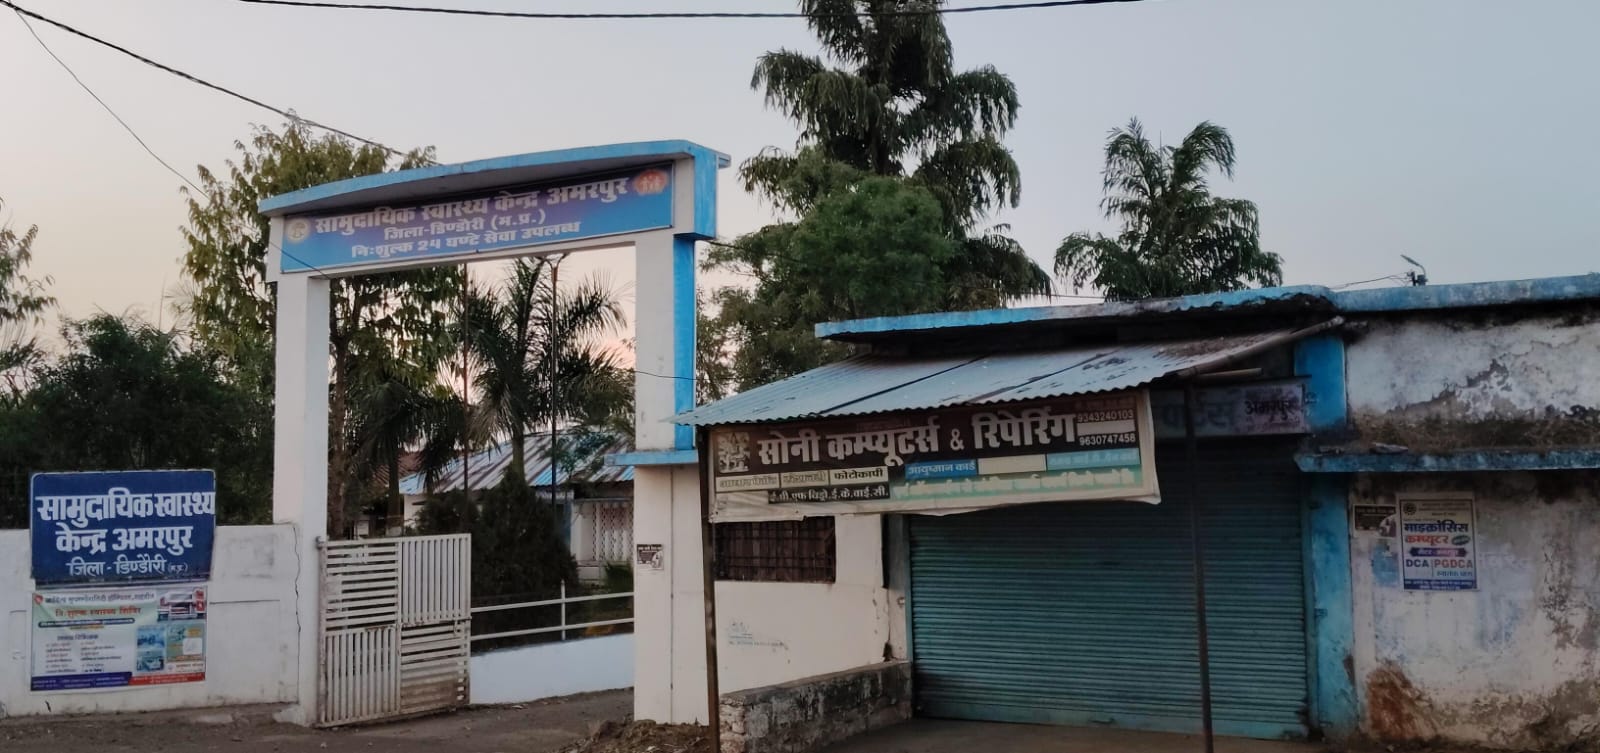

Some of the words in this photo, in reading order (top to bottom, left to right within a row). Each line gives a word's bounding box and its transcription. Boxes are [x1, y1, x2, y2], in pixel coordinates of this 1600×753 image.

[315, 206, 416, 236] सामुदायिक
[421, 199, 488, 222] स्वास्थ्य
[494, 190, 540, 211] केन्द्र
[547, 177, 629, 205] अमरपुर
[446, 231, 480, 248] घण्टे
[484, 229, 516, 244] सेवा
[521, 221, 581, 239] उपलब्ध
[757, 428, 820, 466] सोनी
[826, 417, 941, 466] कम्प्यूटर्स
[949, 430, 965, 452] &
[972, 407, 1076, 449] रिपेरिंग
[1079, 432, 1136, 446] 9630747458
[35, 487, 153, 528] सामुदायिक
[153, 491, 215, 518] स्वास्थ्य
[55, 522, 107, 555] केन्द्र
[112, 526, 193, 556] अमरपुर
[66, 556, 105, 576] जिला
[1406, 560, 1429, 568] DCA
[1434, 560, 1473, 569] PGDCA
